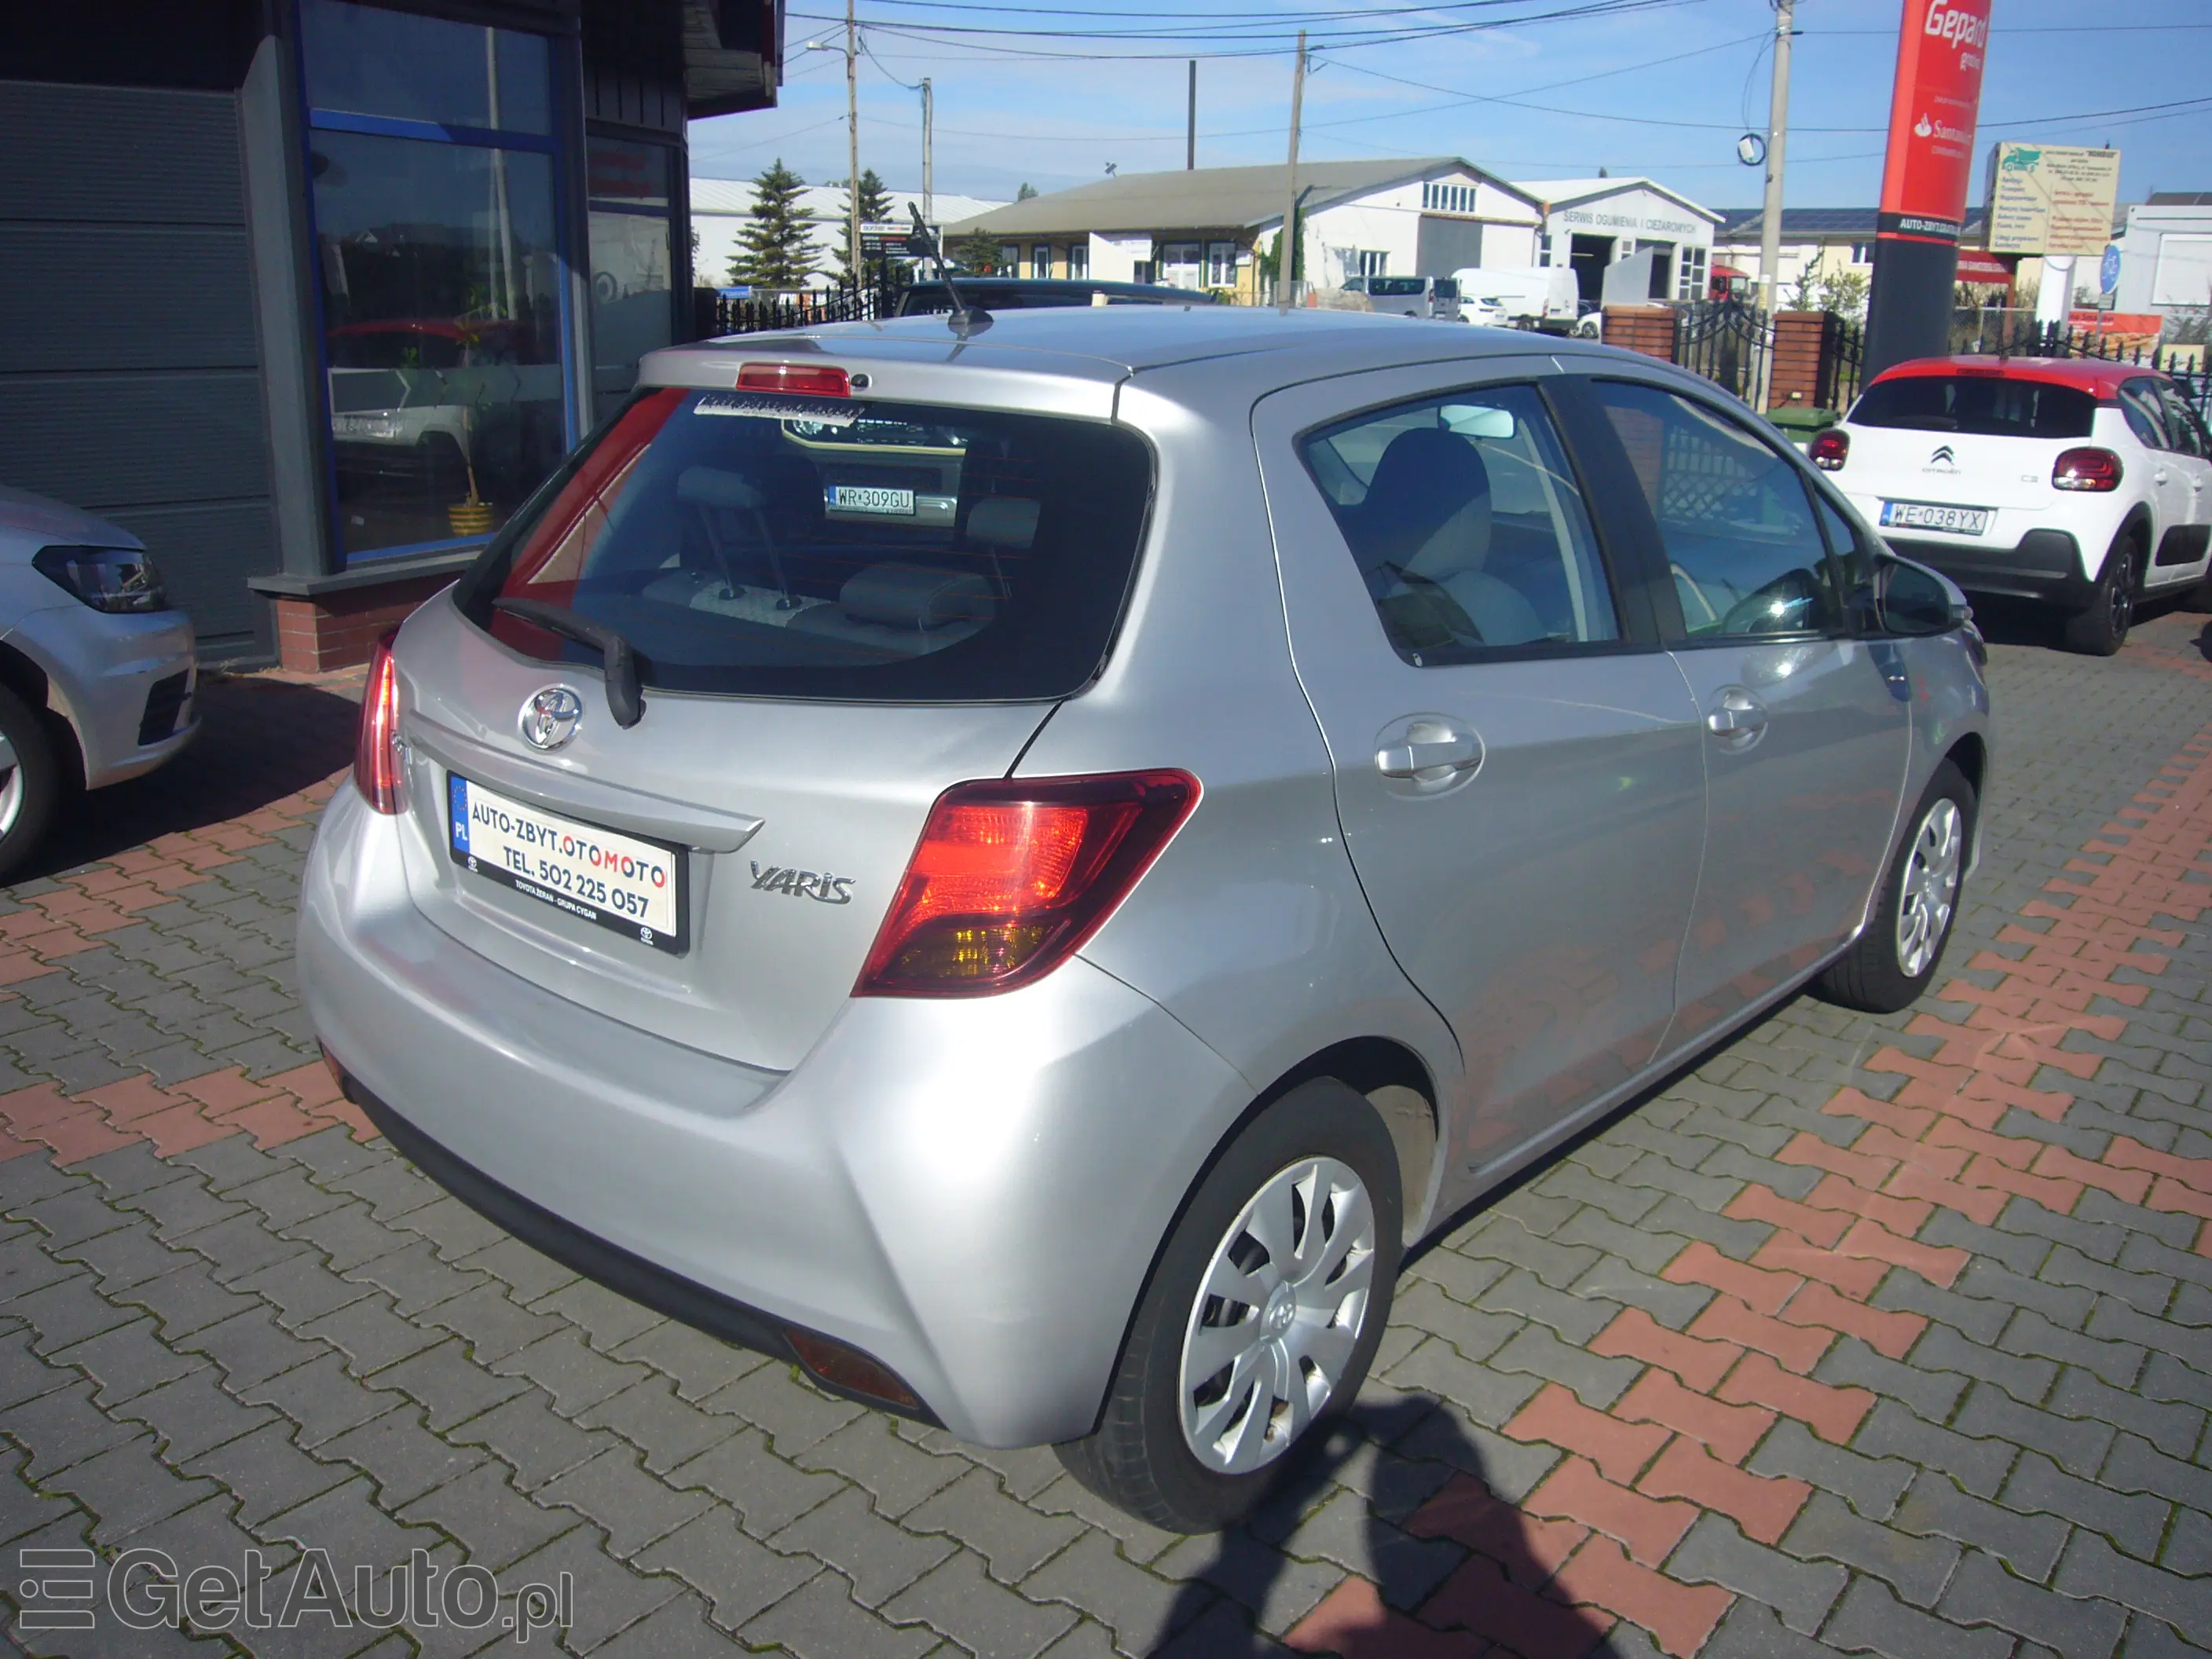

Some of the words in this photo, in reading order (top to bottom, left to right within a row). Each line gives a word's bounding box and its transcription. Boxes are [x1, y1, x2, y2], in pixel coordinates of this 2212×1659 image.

[1563, 211, 1593, 225] SERWIS
[1596, 214, 1637, 228] OGUMIENIA
[455, 821, 468, 841] PL
[472, 801, 665, 888] AUTO-ZBYT.OTOMOTO
[503, 845, 535, 877] TEL.
[539, 859, 573, 892] 502
[576, 874, 607, 904] 225
[612, 888, 650, 917] 057
[515, 879, 536, 894] TOYOTA
[557, 898, 576, 911] GRUPA
[576, 905, 597, 920] CYGAN
